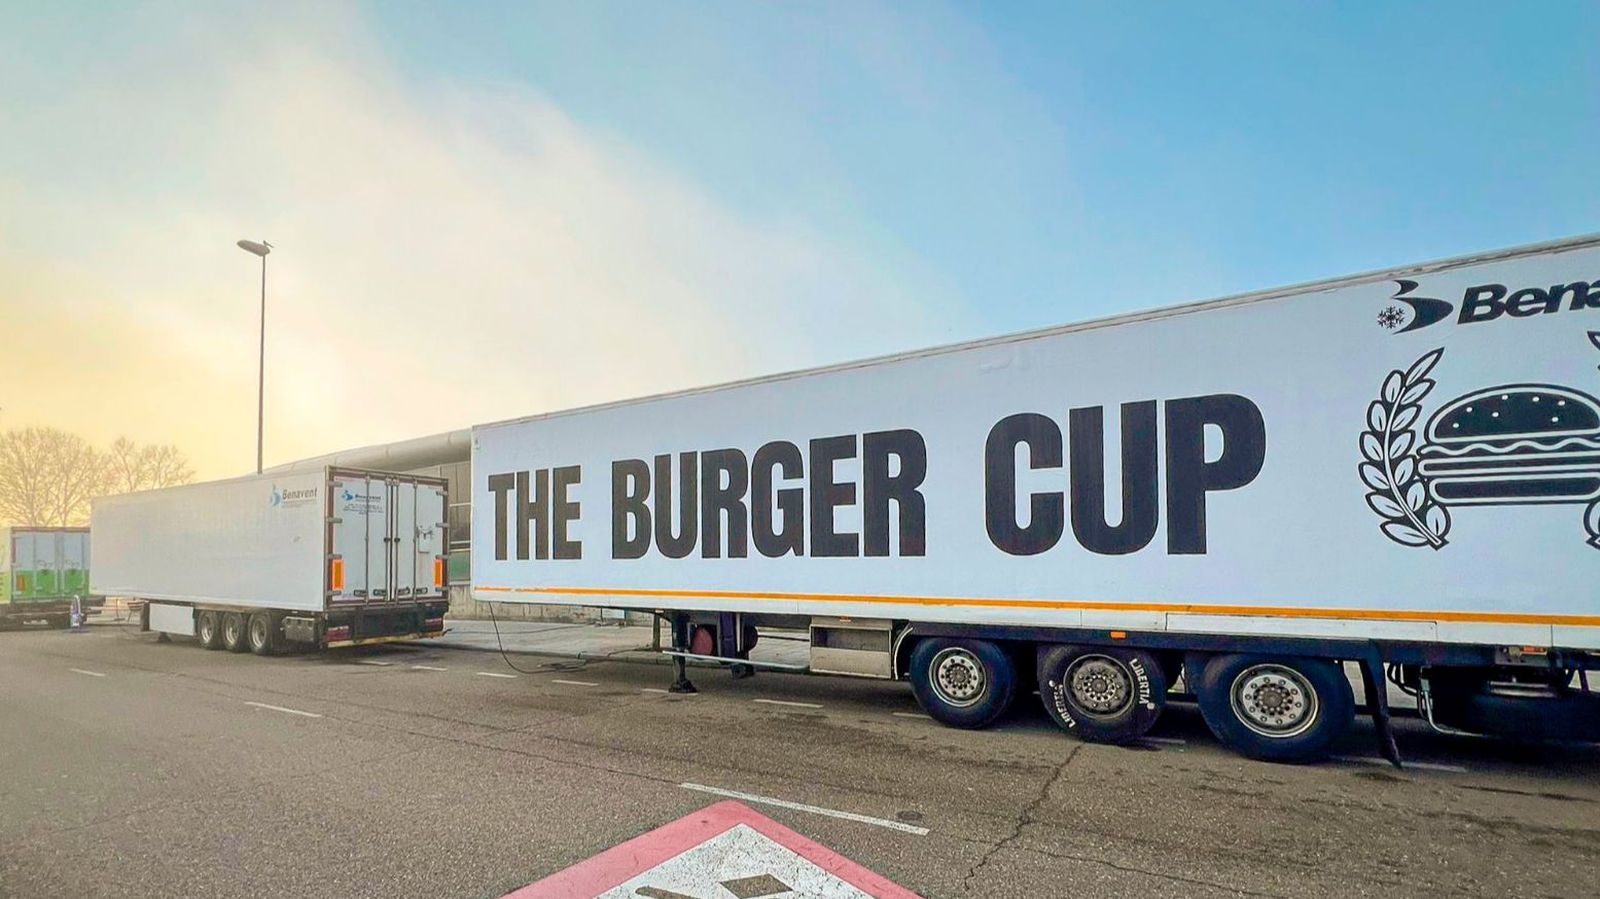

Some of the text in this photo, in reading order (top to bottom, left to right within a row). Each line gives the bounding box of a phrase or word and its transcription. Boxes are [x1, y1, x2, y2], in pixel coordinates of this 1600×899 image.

[488, 393, 1266, 560] THE BURGER CUP
